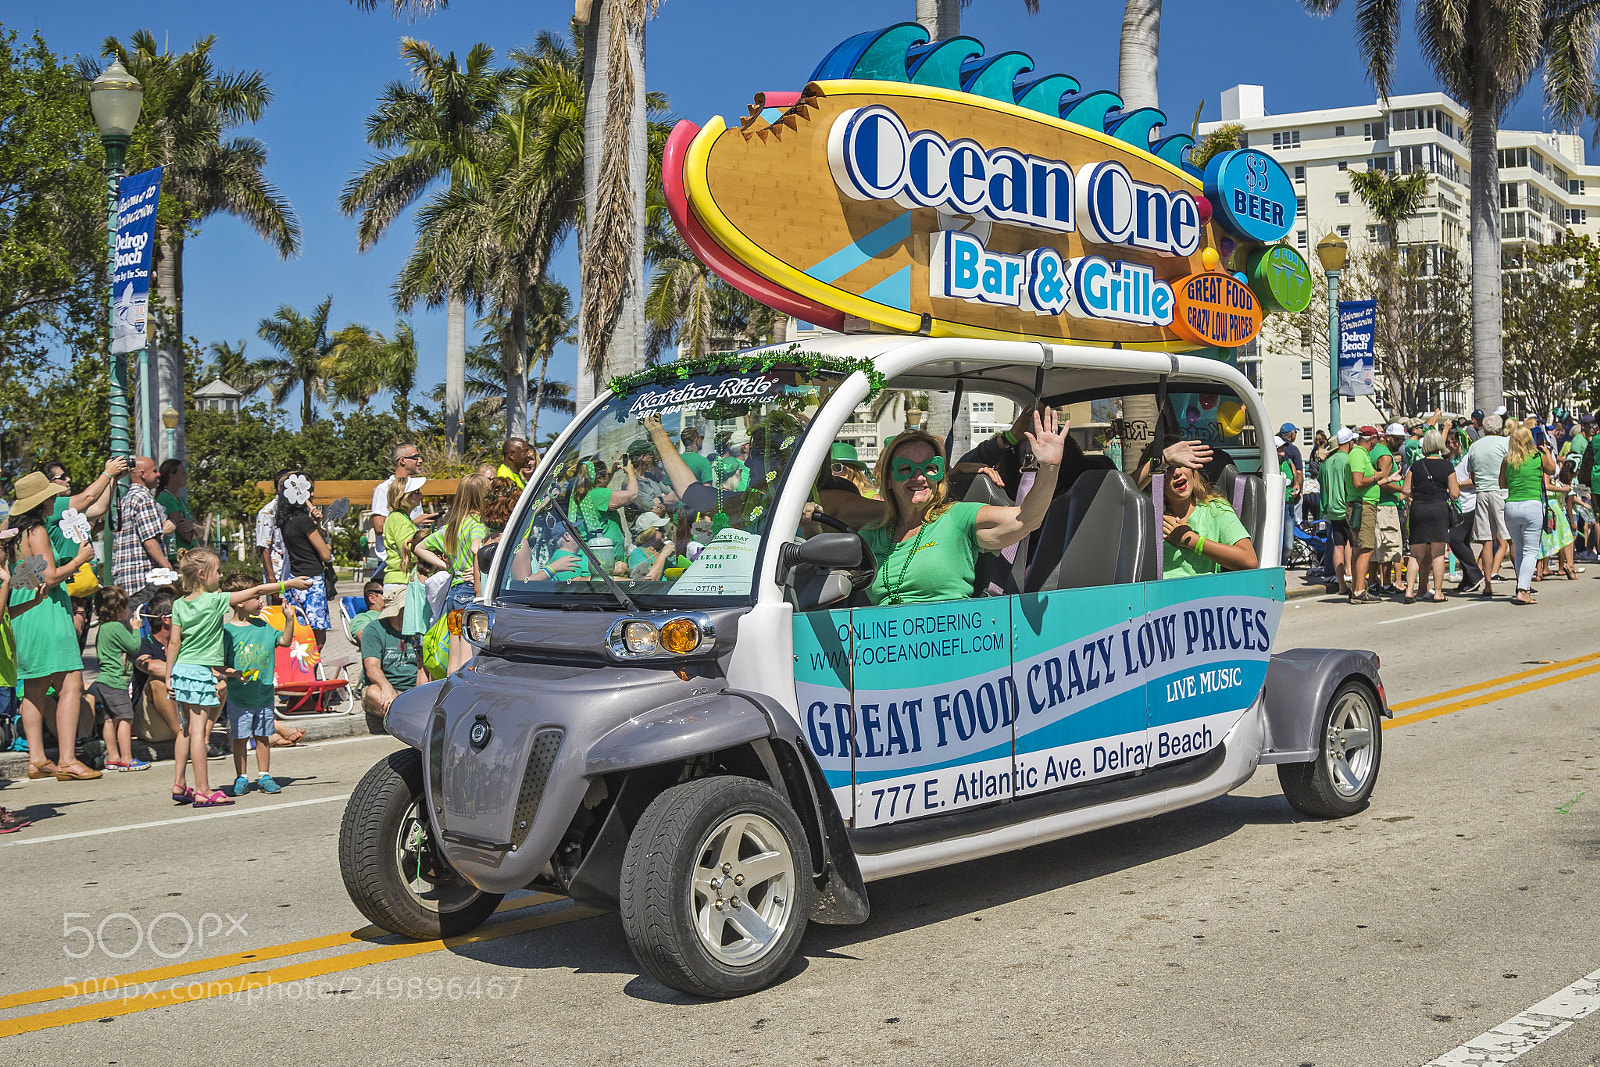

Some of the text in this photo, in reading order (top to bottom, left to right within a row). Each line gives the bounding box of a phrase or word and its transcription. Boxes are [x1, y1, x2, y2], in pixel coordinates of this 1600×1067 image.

[854, 113, 1196, 250] Ocean One
[1246, 153, 1269, 192] $3
[145, 185, 156, 199] to
[1234, 188, 1285, 228] BEER
[115, 231, 149, 252] Delray
[113, 247, 142, 272] Beach
[135, 268, 149, 278] Sea
[1274, 248, 1304, 273] 3 FOR 1
[955, 239, 1171, 320] Bar & Grille
[1187, 277, 1253, 311] GREAT FOOD
[1187, 306, 1253, 342] CRAZY LOW PRICES
[1341, 331, 1371, 343] Delray
[1341, 341, 1368, 353] Beach
[630, 376, 772, 411] Katcha-Ride
[730, 397, 757, 405] WITH
[759, 395, 778, 403] US!
[837, 611, 982, 642] ONLINE ORDERING
[810, 632, 1005, 671] WWW.OCEANONEFL.COM
[807, 606, 1270, 758] GREAT FOOD CRAZY LOW PRICES
[1166, 667, 1242, 703] LIVE MUSIC
[871, 724, 1213, 820] 777 E. Atlantic Ave. Delray Beach
